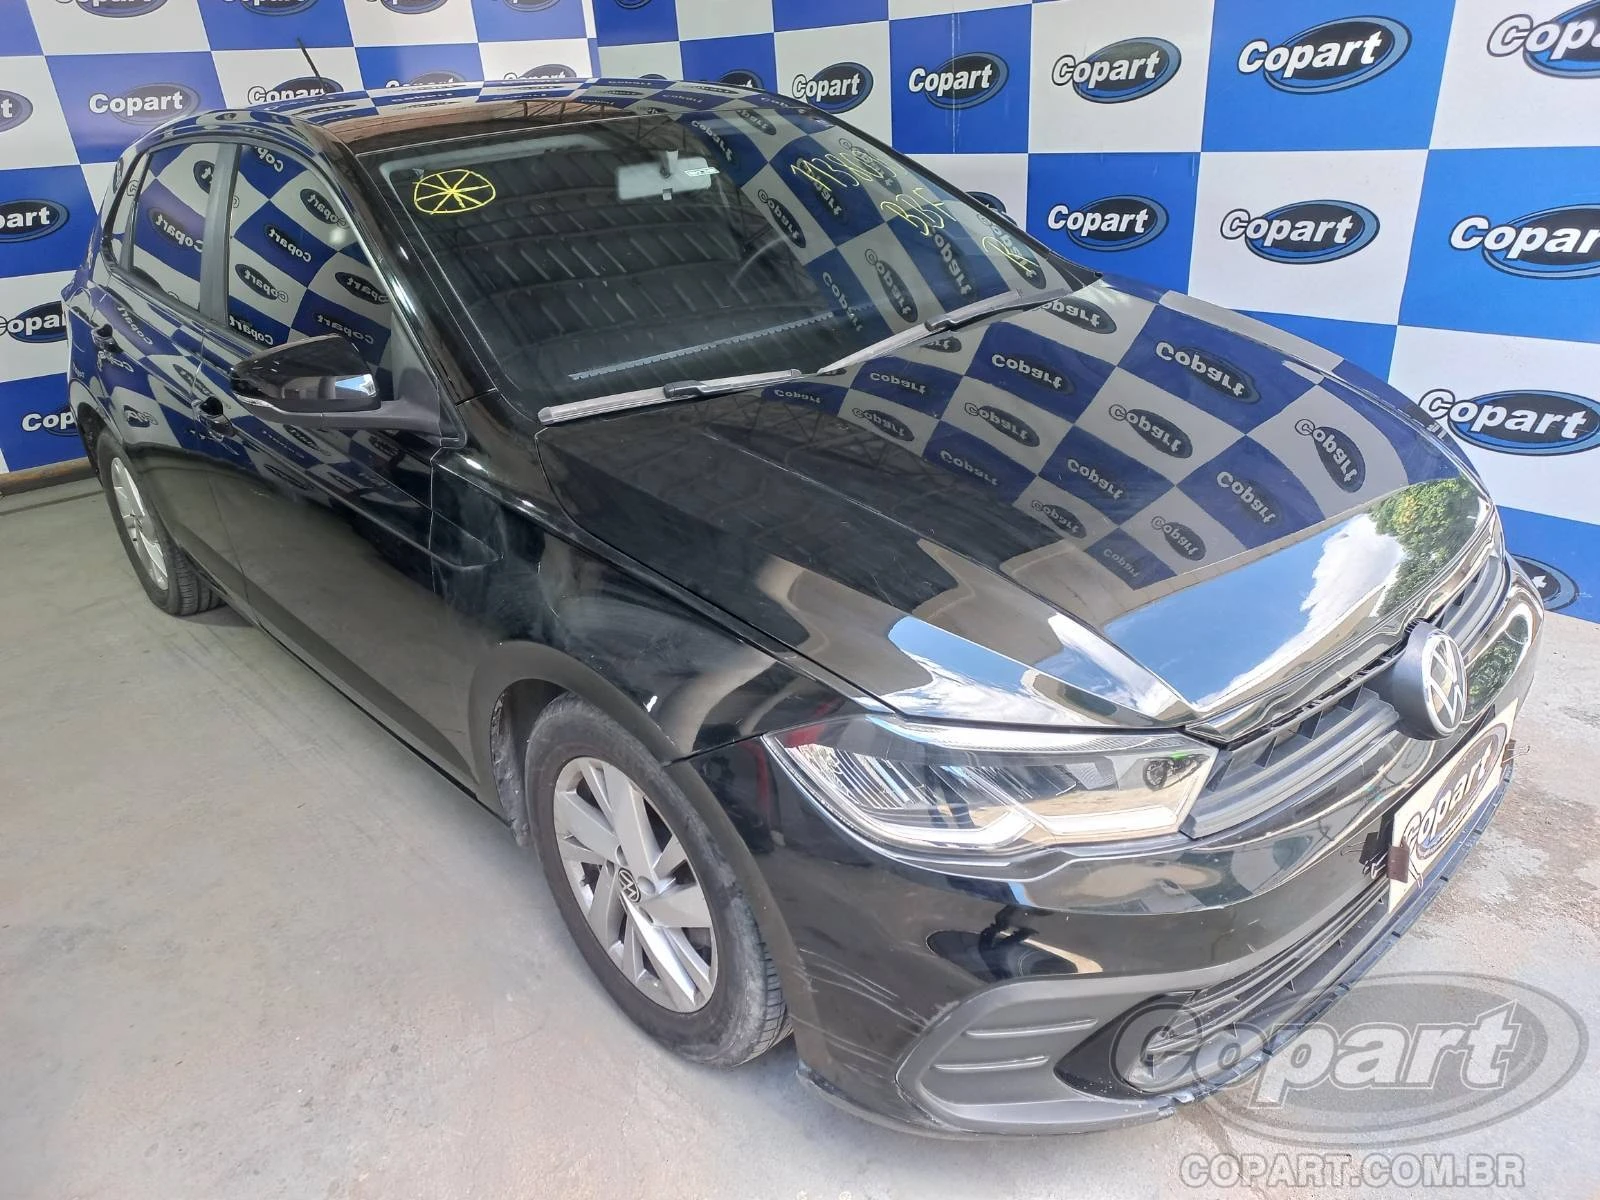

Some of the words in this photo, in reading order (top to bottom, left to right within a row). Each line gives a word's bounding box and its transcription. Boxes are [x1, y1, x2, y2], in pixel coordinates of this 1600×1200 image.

[1239, 31, 1383, 78] Copart
[1488, 15, 1600, 60] Cop
[794, 74, 862, 102] Copart
[909, 64, 993, 97] Copart
[1053, 51, 1160, 88] Copart
[89, 91, 184, 116] Copart
[1048, 205, 1149, 237] Copart
[1221, 209, 1354, 247] Copart
[1419, 389, 1587, 439] Copart
[1402, 740, 1493, 848] Copart
